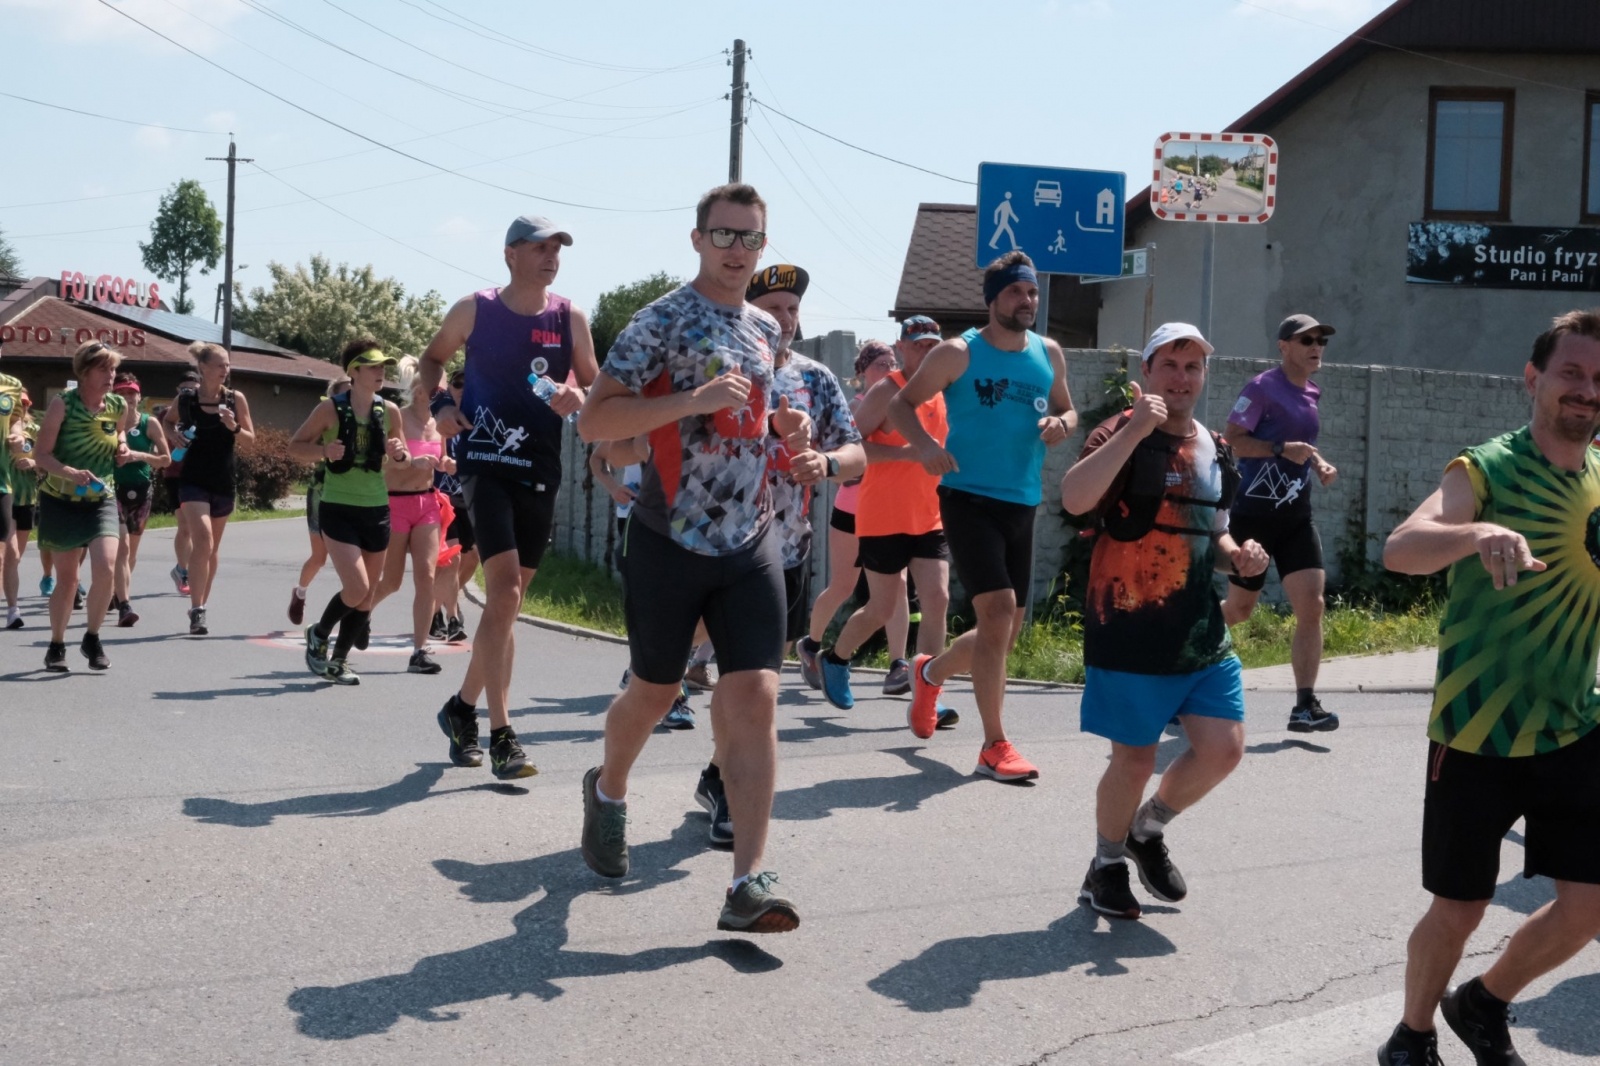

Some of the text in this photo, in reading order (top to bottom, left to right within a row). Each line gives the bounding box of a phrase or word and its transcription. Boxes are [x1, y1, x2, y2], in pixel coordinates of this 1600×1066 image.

[1474, 244, 1546, 265] Studio
[1510, 268, 1537, 281] Pan
[1552, 270, 1584, 283] Pani
[60, 327, 146, 347] FOCUS
[531, 329, 561, 344] RUN
